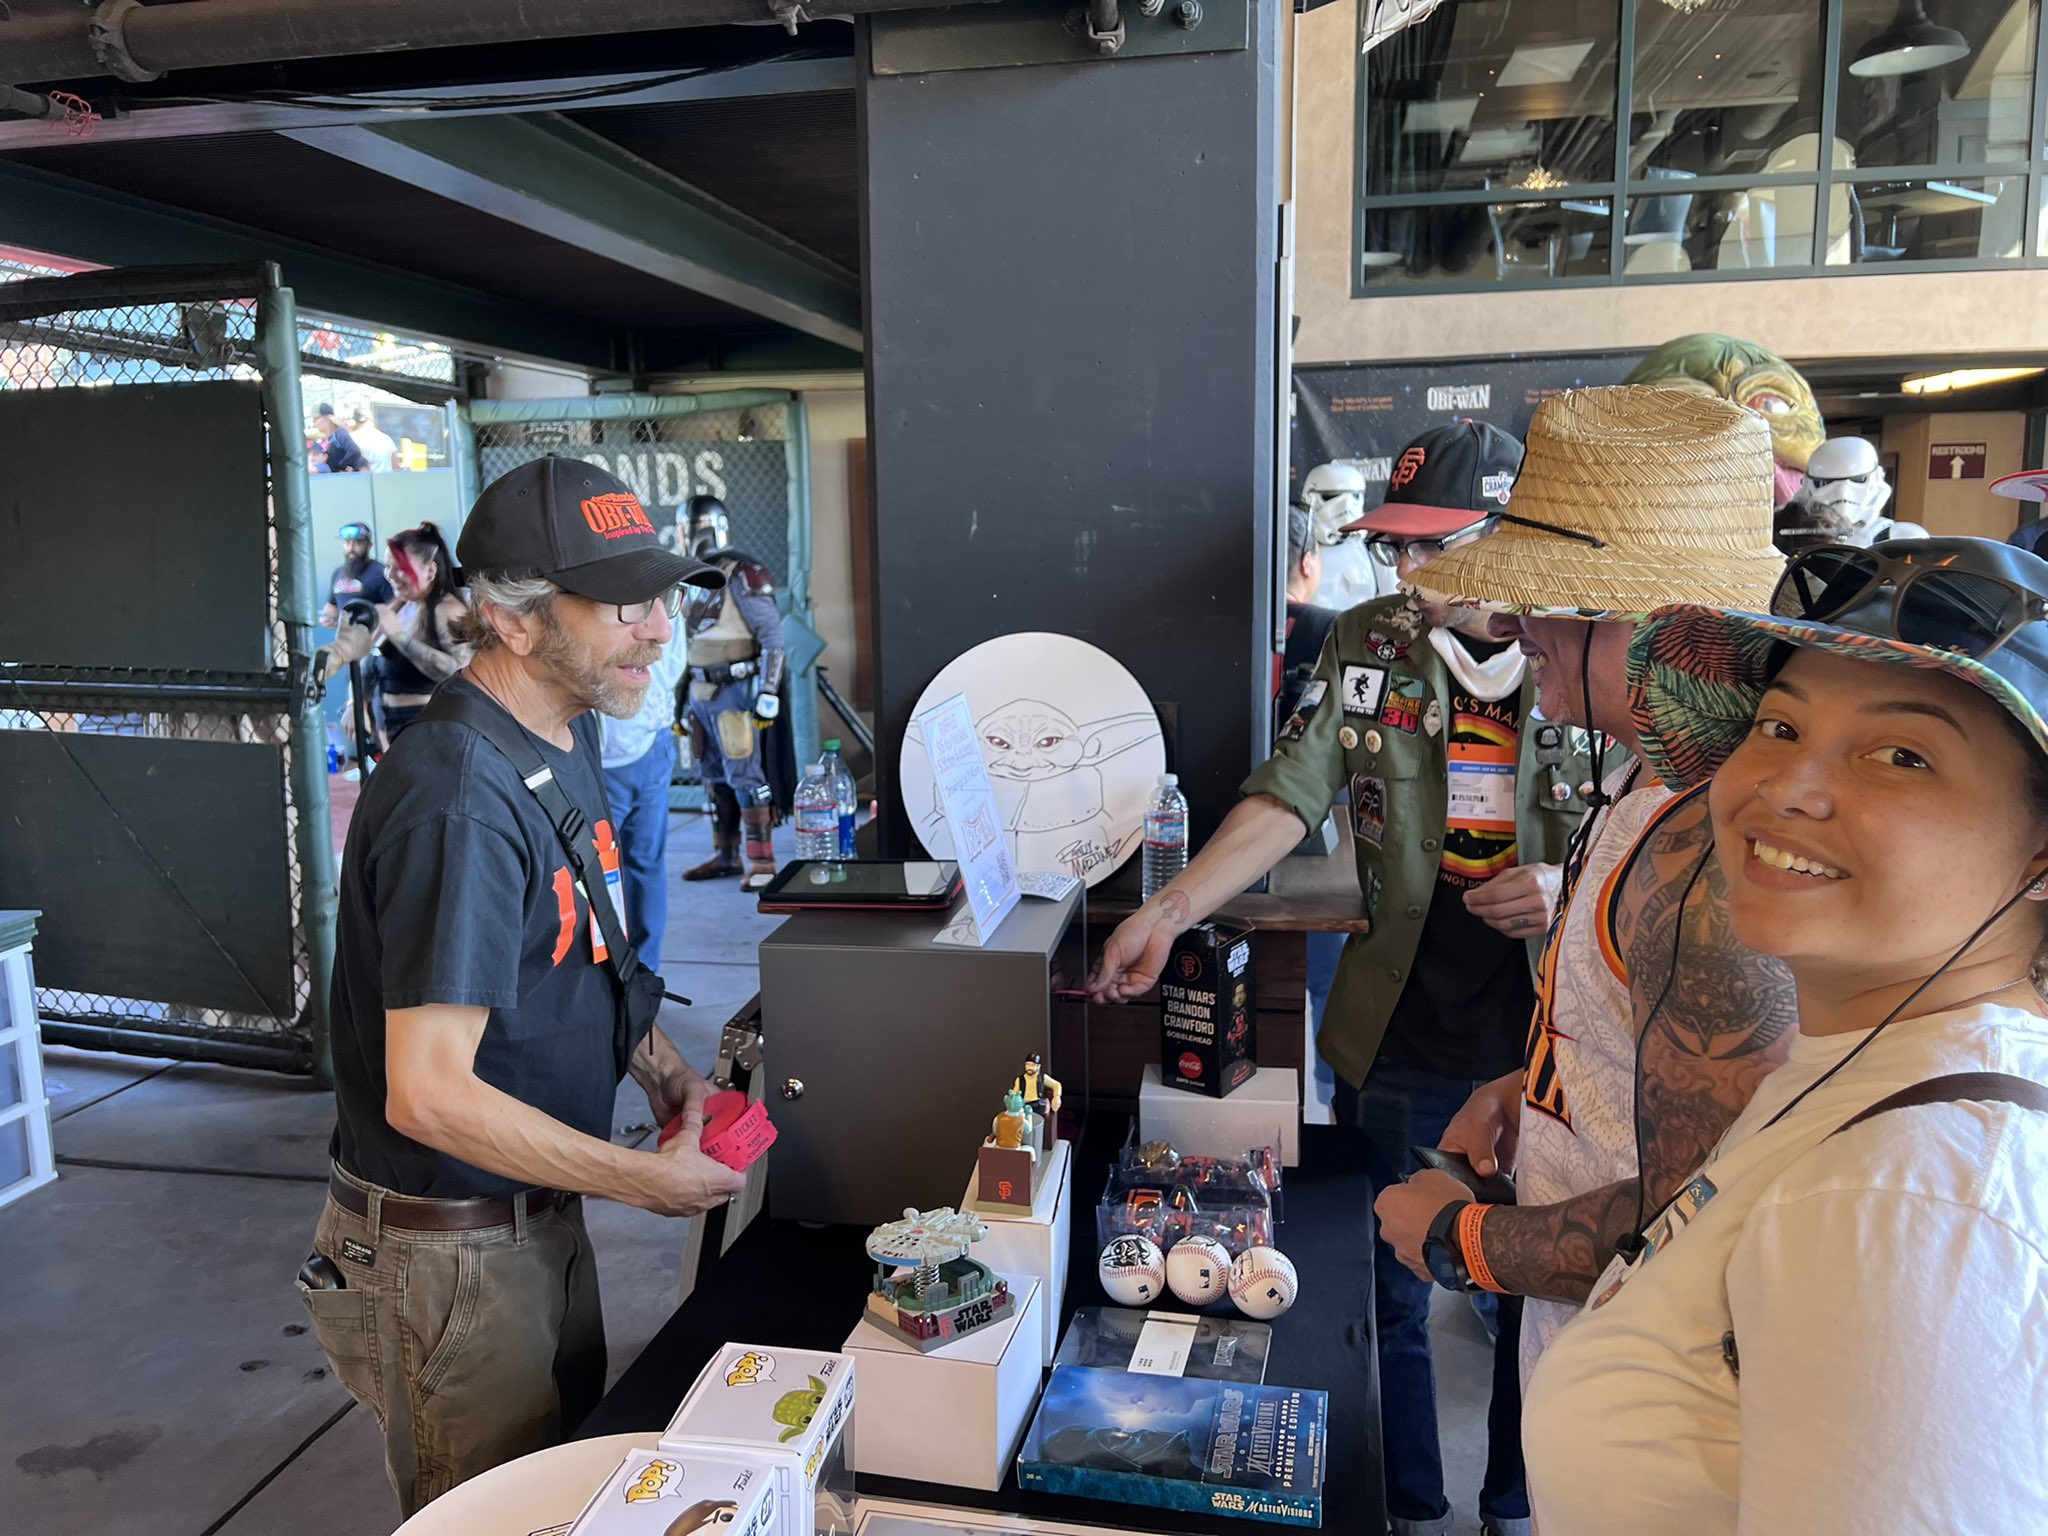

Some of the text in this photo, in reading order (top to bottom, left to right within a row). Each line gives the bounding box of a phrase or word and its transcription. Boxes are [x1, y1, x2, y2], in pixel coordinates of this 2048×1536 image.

[1426, 384, 1490, 411] OBI-WAN
[1931, 445, 1985, 456] RESTROOMS
[1391, 446, 1426, 491] SF
[581, 499, 653, 534] OBI-W
[1454, 695, 1479, 713] O'S
[1440, 871, 1465, 888] INGS
[1181, 955, 1196, 977] SF
[1162, 984, 1216, 1005] STAR WARS
[1167, 1000, 1211, 1019] BRANDON
[1163, 1015, 1214, 1035] CRAWFORD
[1166, 1030, 1212, 1046] BOBBLEHEAD
[734, 1114, 758, 1138] TICKET
[702, 1142, 722, 1155] KET
[998, 1180, 1012, 1200] SF
[954, 1300, 992, 1322] STAR
[954, 1309, 993, 1334] WARS
[727, 1351, 769, 1387] POP!
[1218, 1389, 1244, 1433] WARS
[1275, 1400, 1289, 1478] COLLECTOR CARDS
[1283, 1392, 1300, 1487] PREMIERE EDITION
[1211, 1432, 1238, 1479] STAR
[625, 1459, 677, 1504] POP!
[1211, 1492, 1242, 1502] STAR
[1211, 1499, 1245, 1511] WARS
